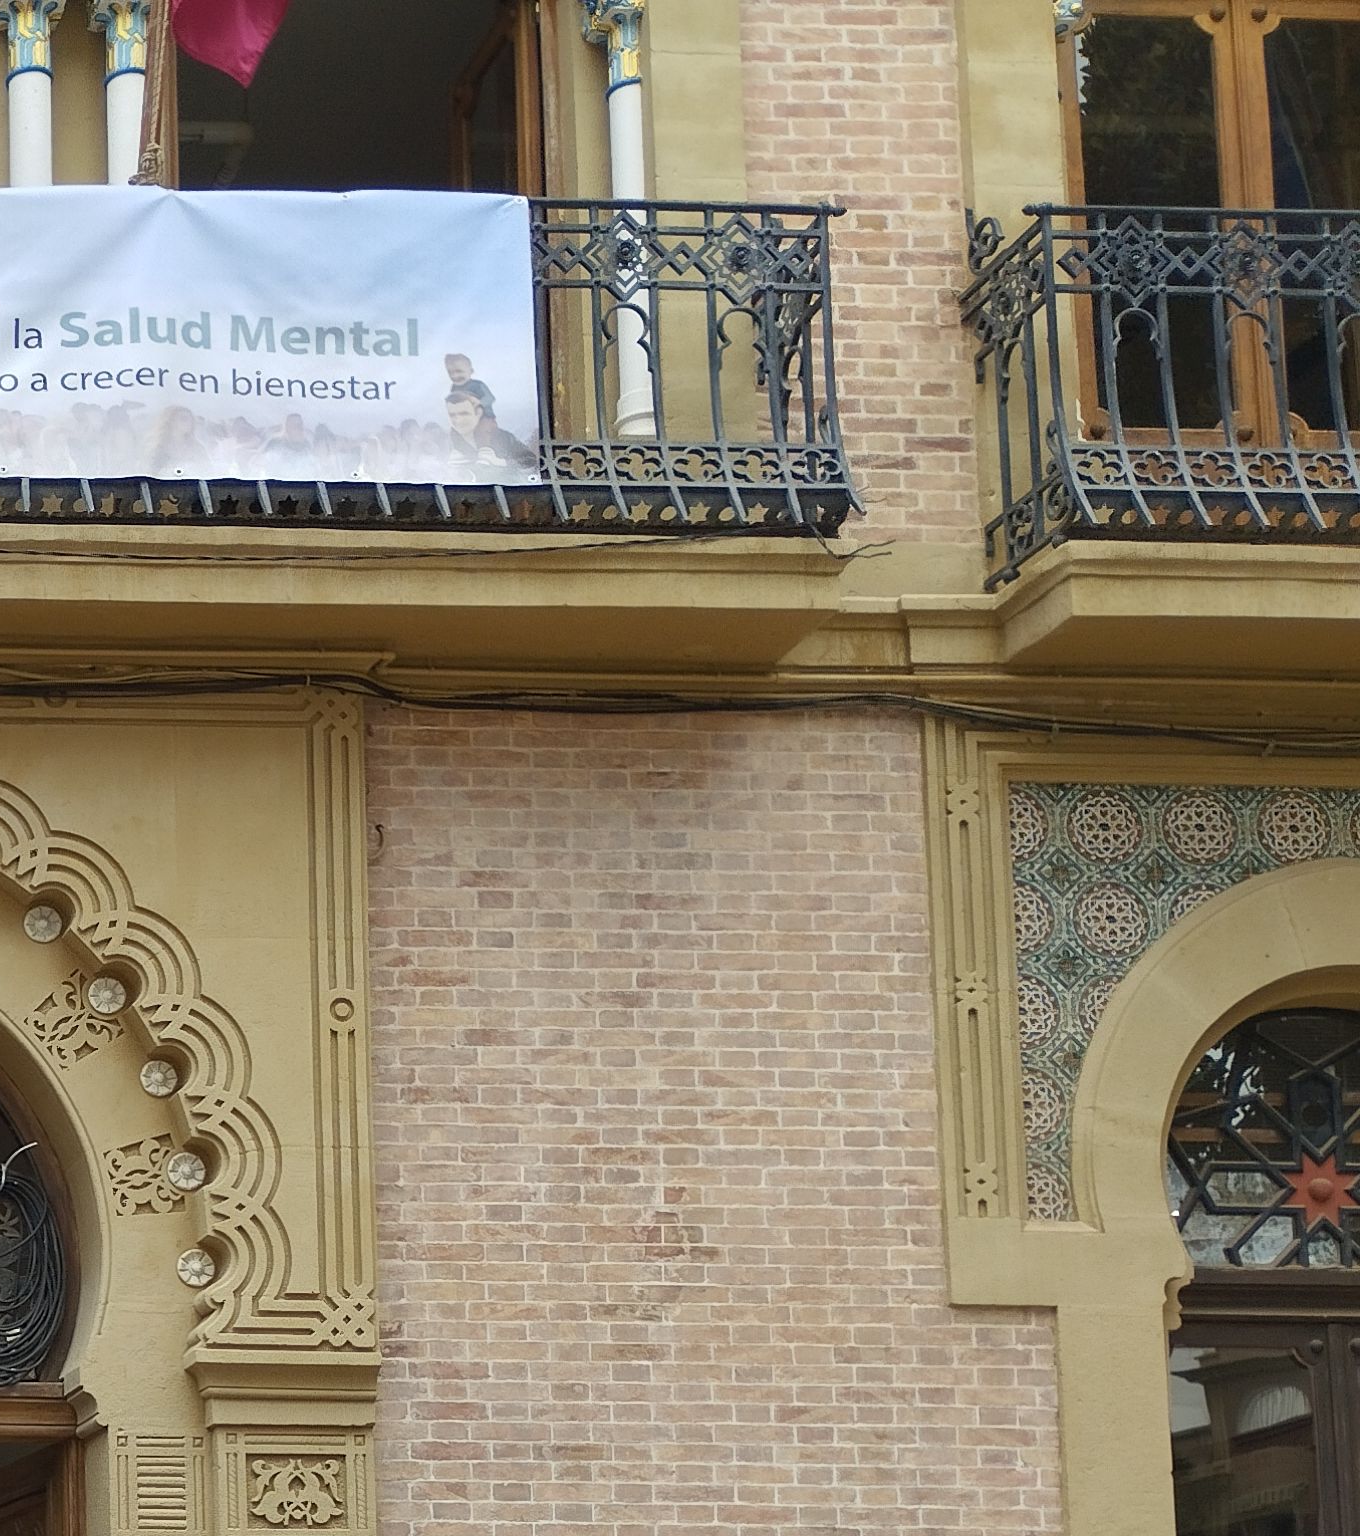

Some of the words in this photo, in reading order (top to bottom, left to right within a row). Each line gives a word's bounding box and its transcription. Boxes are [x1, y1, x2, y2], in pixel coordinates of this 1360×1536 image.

[13, 317, 43, 349] la
[59, 306, 212, 350] Salud
[230, 313, 420, 357] Mental
[30, 372, 48, 392] a
[59, 366, 170, 392] crecer
[178, 371, 220, 394] en
[231, 368, 397, 400] bienestar
